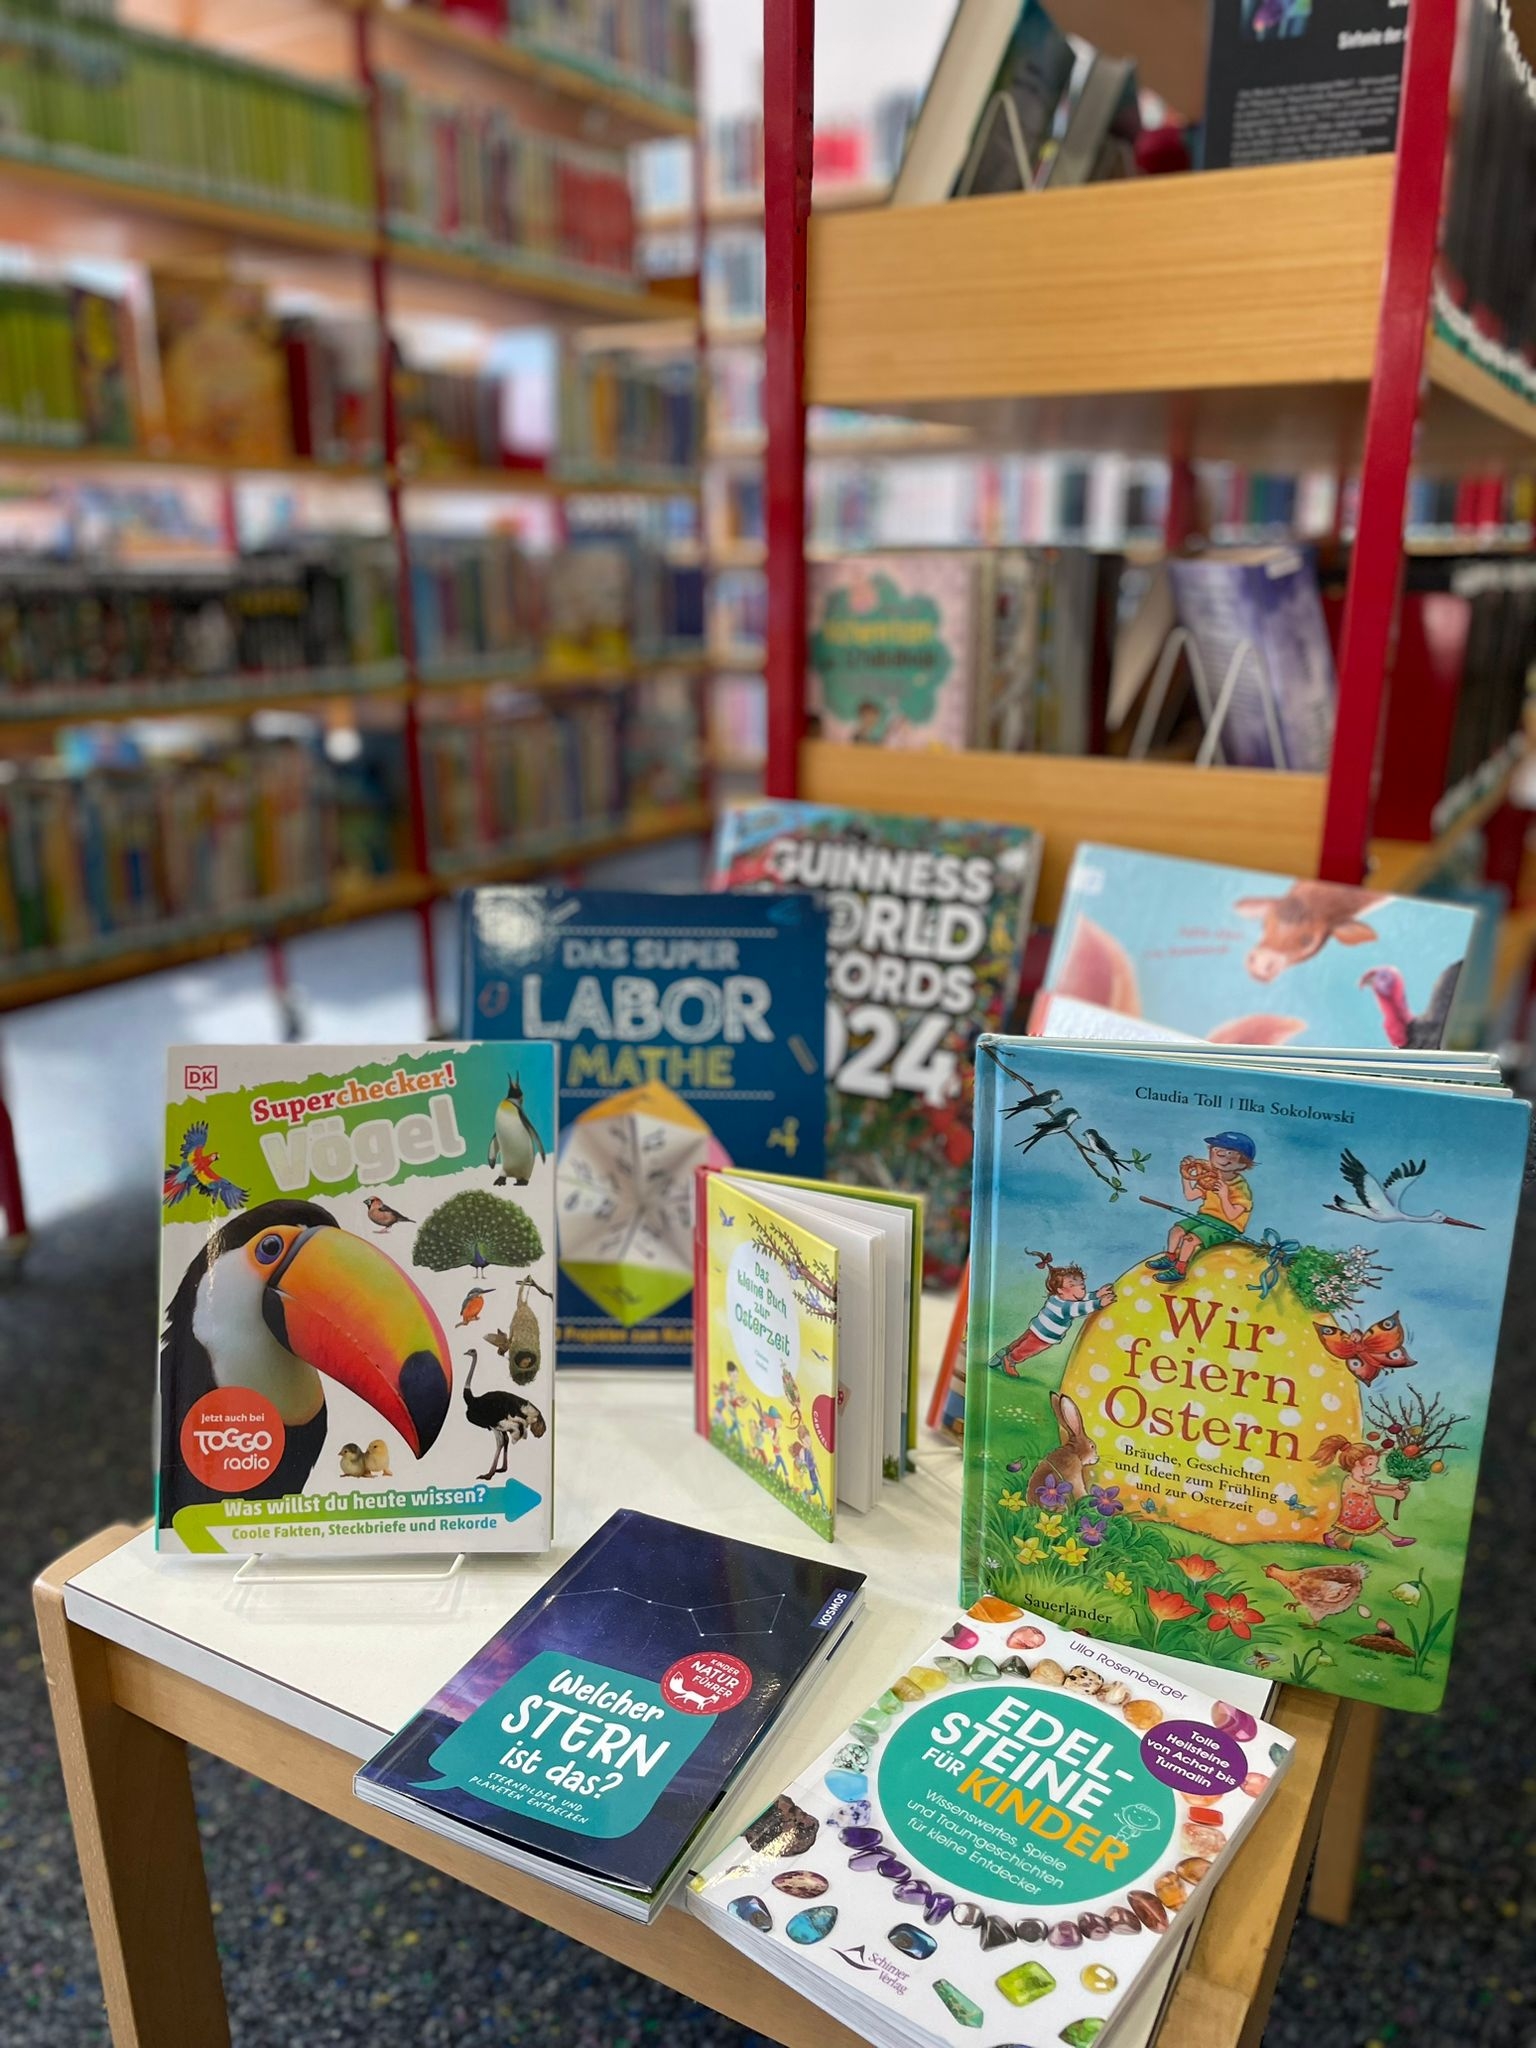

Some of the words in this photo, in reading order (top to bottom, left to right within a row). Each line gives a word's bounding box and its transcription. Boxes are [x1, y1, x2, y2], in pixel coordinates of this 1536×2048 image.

[764, 838, 994, 904] GUINNESS
[826, 894, 986, 963] ORLD
[562, 938, 629, 970] DAS
[633, 938, 740, 971] SUPER
[827, 954, 976, 1014] ORDS
[522, 973, 775, 1044] LABOR
[567, 1043, 735, 1089] MATHE
[825, 1002, 960, 1107] 24
[189, 1071, 213, 1086] DK
[253, 1063, 455, 1123] Superchecker!
[1135, 1086, 1188, 1104] Claudia
[1194, 1093, 1222, 1108] Toll
[1239, 1098, 1265, 1113] Ilka
[1270, 1102, 1355, 1124] Sokolowski
[260, 1095, 466, 1191] Vögel
[755, 1262, 769, 1284] Das
[754, 1302, 770, 1320] zur
[767, 1289, 787, 1319] Buch
[1160, 1293, 1275, 1353] Wir
[735, 1303, 790, 1357] Osterzeit
[1124, 1338, 1299, 1407] feiern
[225, 1413, 248, 1422] auch
[249, 1412, 265, 1422] bei
[1105, 1385, 1302, 1462] Ostern
[193, 1427, 273, 1456] TOGGO
[223, 1453, 270, 1470] radio
[1115, 1462, 1139, 1474] und
[1144, 1465, 1180, 1482] Ideen
[1186, 1476, 1213, 1489] zum
[1219, 1479, 1278, 1504] Frühling
[1125, 1444, 1181, 1468] Bräuche,
[1187, 1457, 1271, 1484] Geschichten
[224, 1501, 262, 1518] Was
[267, 1496, 320, 1515] willst
[325, 1495, 348, 1512] du
[353, 1491, 407, 1511] heute
[411, 1487, 486, 1506] wissen?
[1136, 1482, 1160, 1494] und
[1165, 1488, 1187, 1500] zur
[1191, 1491, 1253, 1513] Osterzeit
[232, 1526, 271, 1540] Coole
[274, 1524, 325, 1539] Fakten,
[328, 1519, 406, 1537] Steckbriefe
[410, 1518, 436, 1533] und
[440, 1516, 497, 1531] Rekorde
[818, 1593, 847, 1626] KOSMOS
[1024, 1593, 1112, 1624] Sauerländer
[690, 1660, 740, 1689] NATUR
[692, 1675, 733, 1698] FÜHRER
[710, 1659, 740, 1676] KINDER
[1069, 1640, 1095, 1658] Ulla
[1096, 1652, 1189, 1701] Rosenberger
[548, 1668, 665, 1723] Welcher
[501, 1694, 671, 1777] STERN
[986, 1695, 1134, 1782] EDEL-
[1166, 1733, 1230, 1769] Heilsteine
[1190, 1730, 1220, 1751] Tolle
[499, 1740, 542, 1775] ist
[545, 1760, 624, 1799] das?
[931, 1712, 1112, 1820] STEINE
[1147, 1738, 1171, 1755] von
[1172, 1751, 1215, 1775] Achat
[1215, 1770, 1237, 1786] bis
[1155, 1755, 1212, 1788] Turmalin
[468, 1775, 524, 1801] PLANETEN
[526, 1797, 589, 1824] ENTDECKEN
[488, 1772, 557, 1803] STERNBILDER
[561, 1798, 583, 1812] UND
[921, 1745, 966, 1777] FÜR
[957, 1767, 1131, 1872] KINDER
[906, 1799, 935, 1819] und
[936, 1813, 1065, 1889] Traumgeschichten
[926, 1788, 1018, 1847] Wissenswertes,
[1022, 1842, 1067, 1871] Spiele
[907, 1817, 928, 1832] für
[926, 1827, 967, 1856] kleine
[969, 1850, 1042, 1895] Entdecker
[879, 1970, 908, 1996] Verlag
